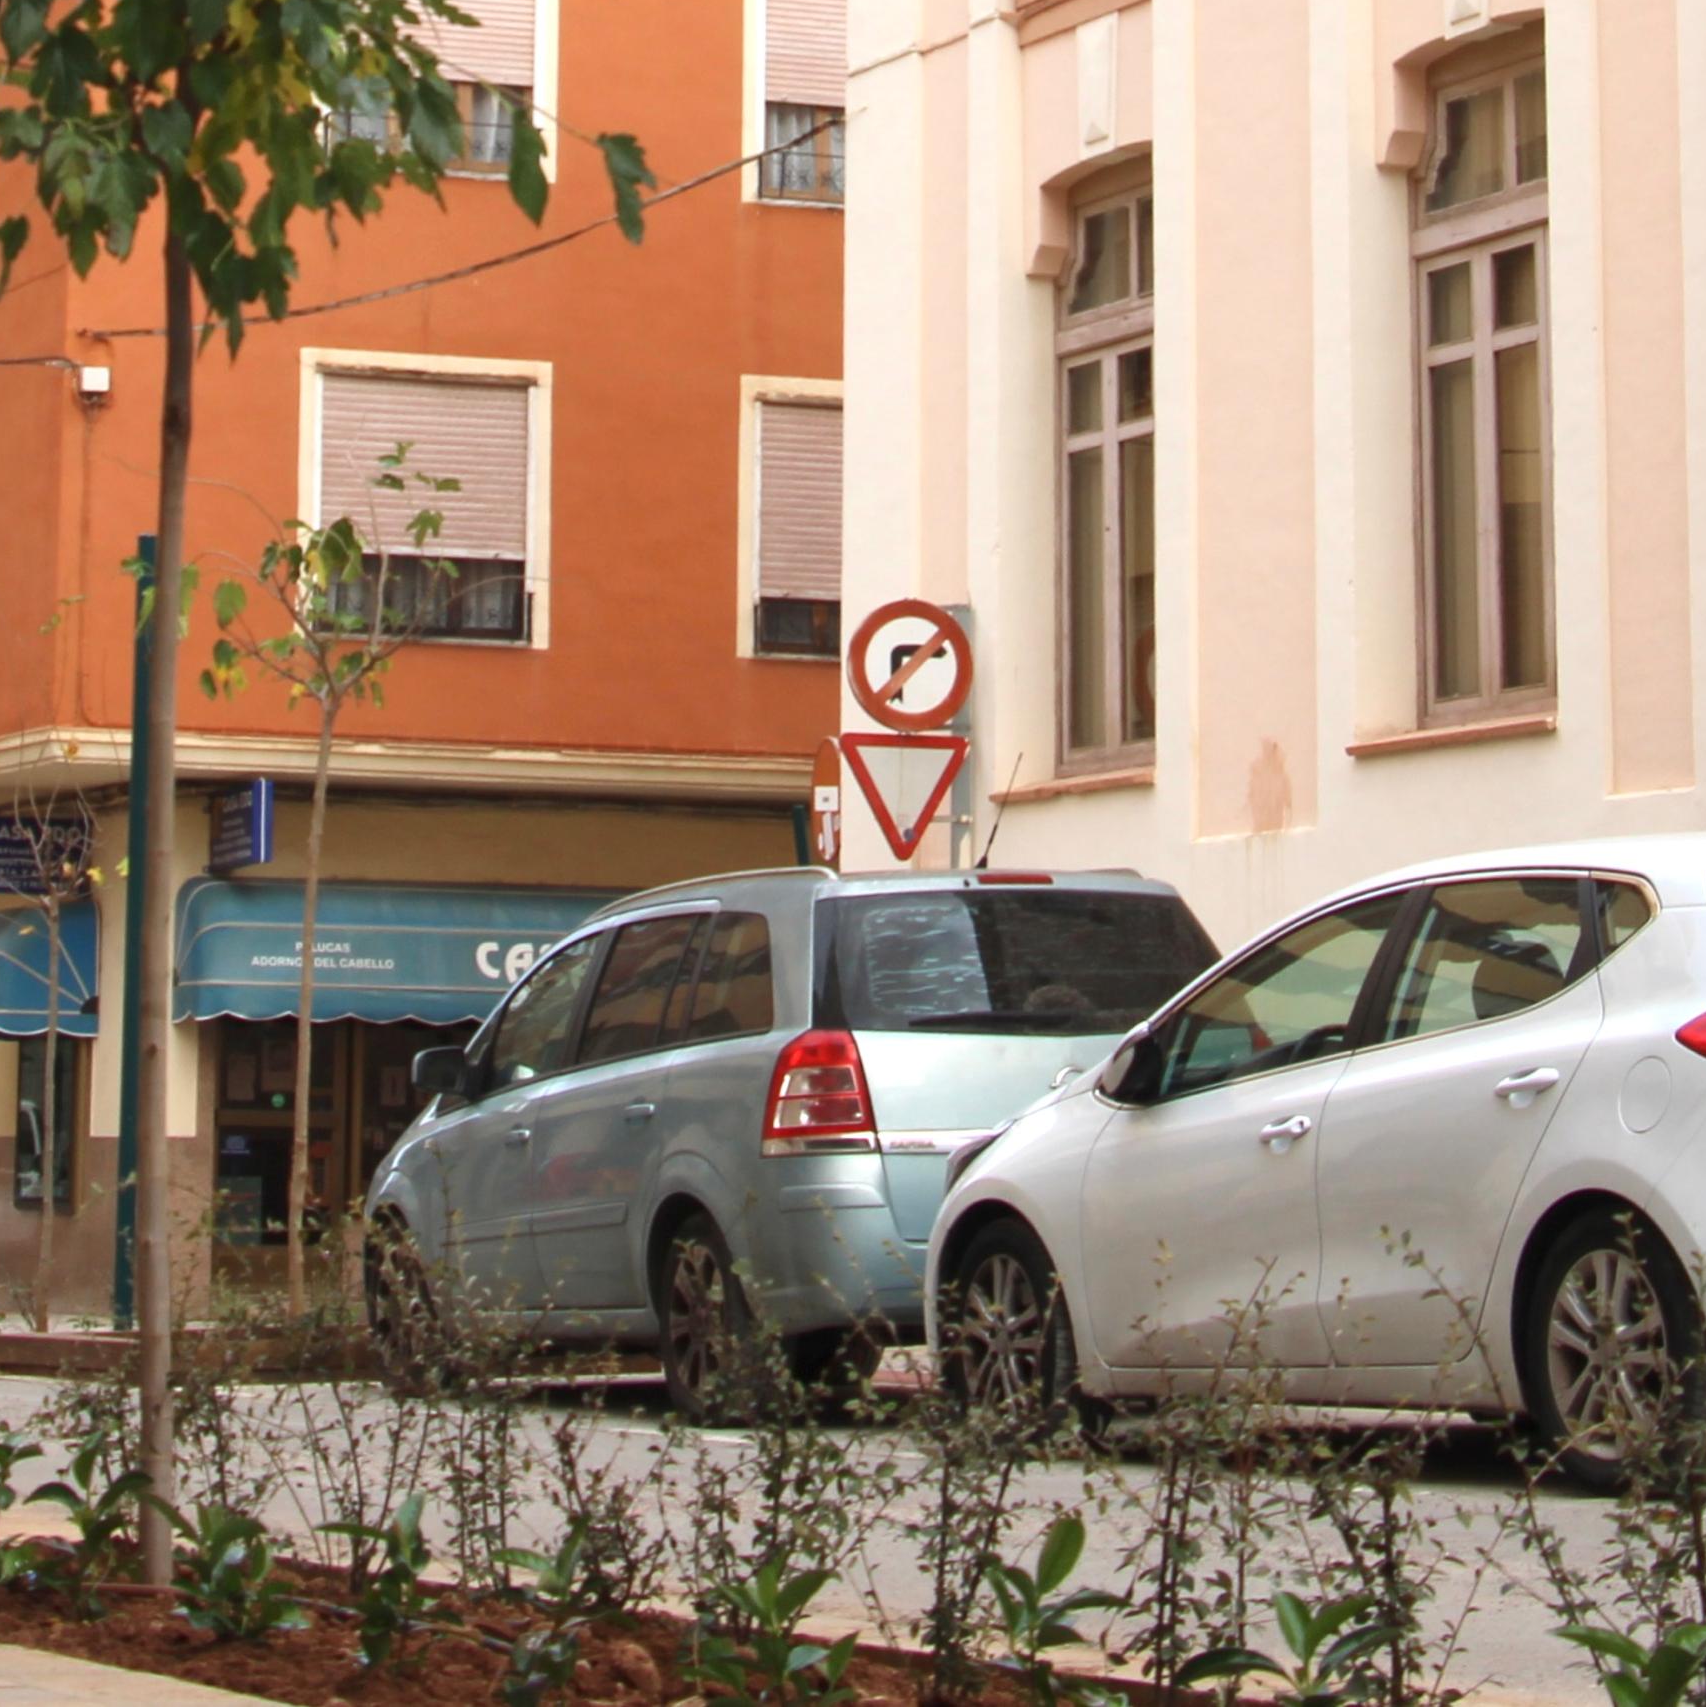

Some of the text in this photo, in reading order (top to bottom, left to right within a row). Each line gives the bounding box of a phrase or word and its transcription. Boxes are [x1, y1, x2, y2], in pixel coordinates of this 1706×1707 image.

[295, 942, 351, 953] PLUCAS
[251, 955, 395, 970] ADORNO DEL CABELLO
